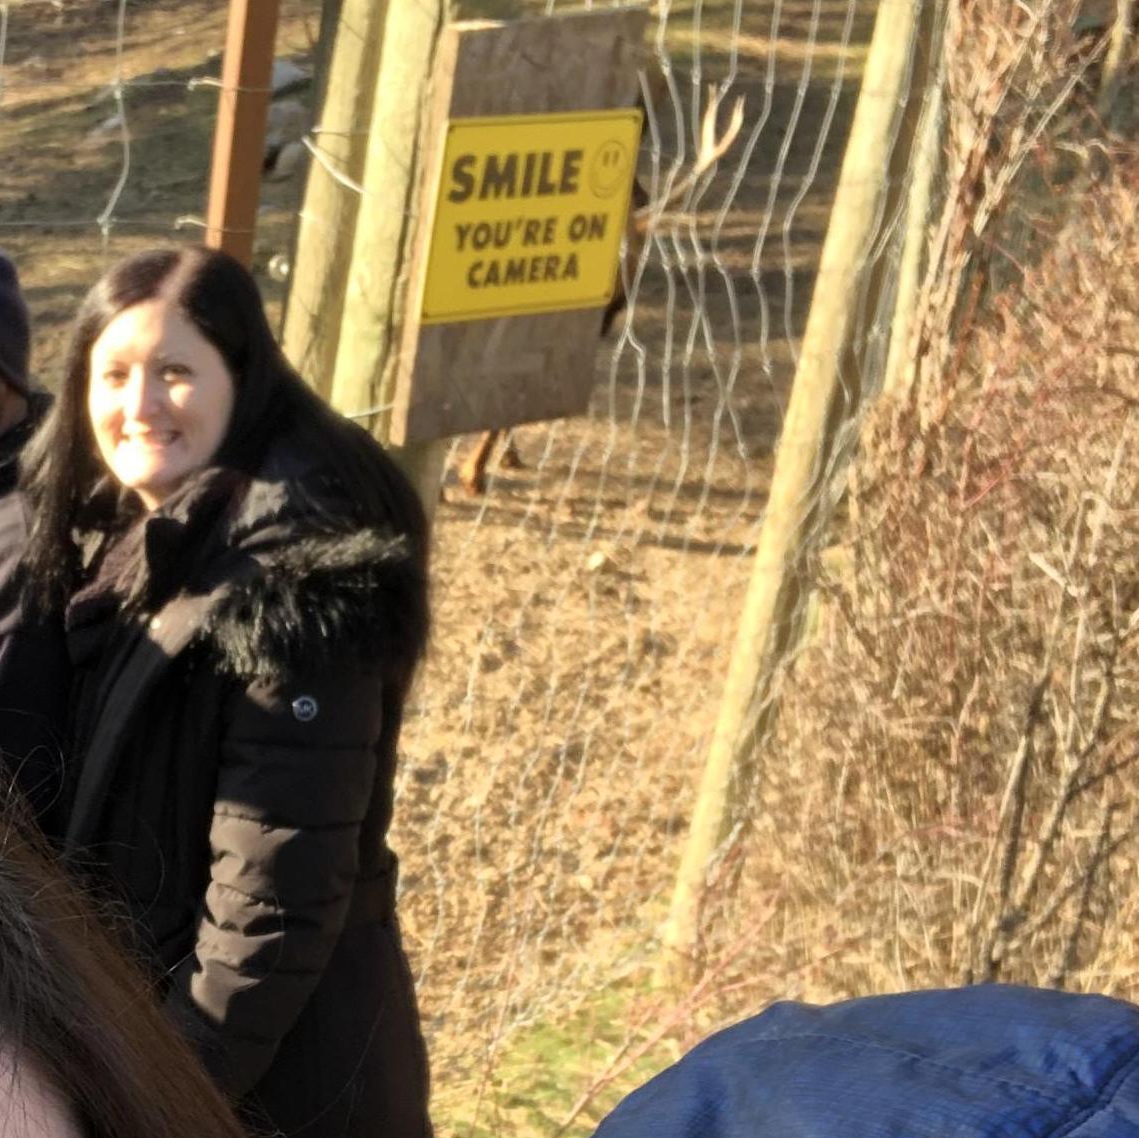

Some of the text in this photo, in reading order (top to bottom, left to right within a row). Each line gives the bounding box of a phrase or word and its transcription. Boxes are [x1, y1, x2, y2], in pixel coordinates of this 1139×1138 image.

[449, 150, 583, 203] SMILE
[455, 214, 607, 250] YOU'RE ON
[468, 254, 578, 288] CAMERA
